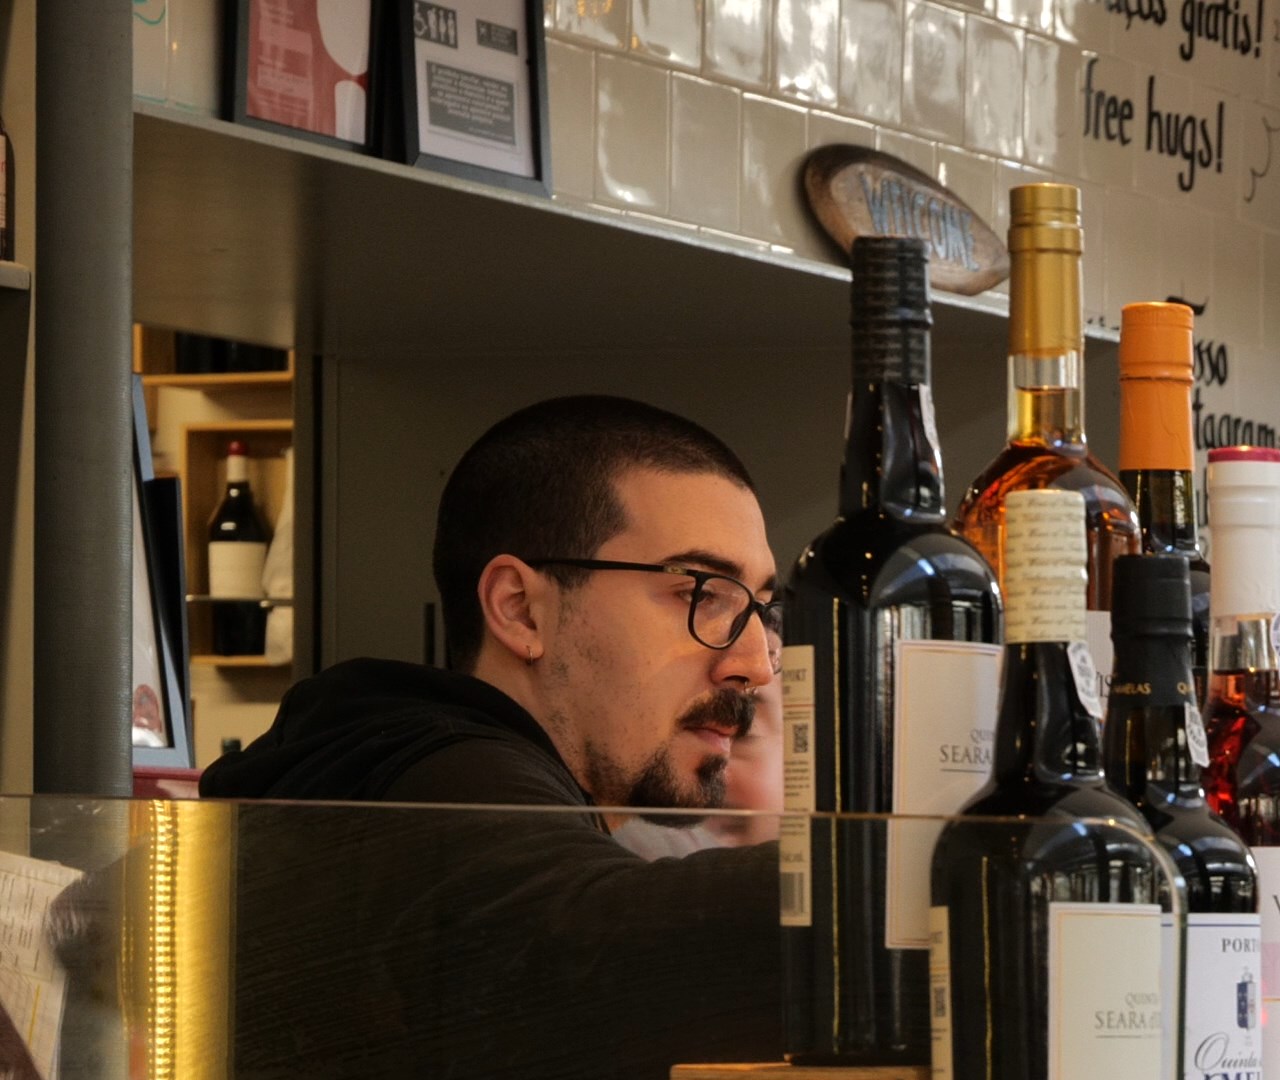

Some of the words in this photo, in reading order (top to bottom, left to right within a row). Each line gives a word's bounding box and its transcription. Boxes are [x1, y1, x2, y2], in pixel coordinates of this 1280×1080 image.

[1083, 57, 1134, 146] free
[1145, 75, 1225, 192] hugs!
[859, 171, 980, 272] WELCOME
[1094, 1010, 1147, 1030] SEARA
